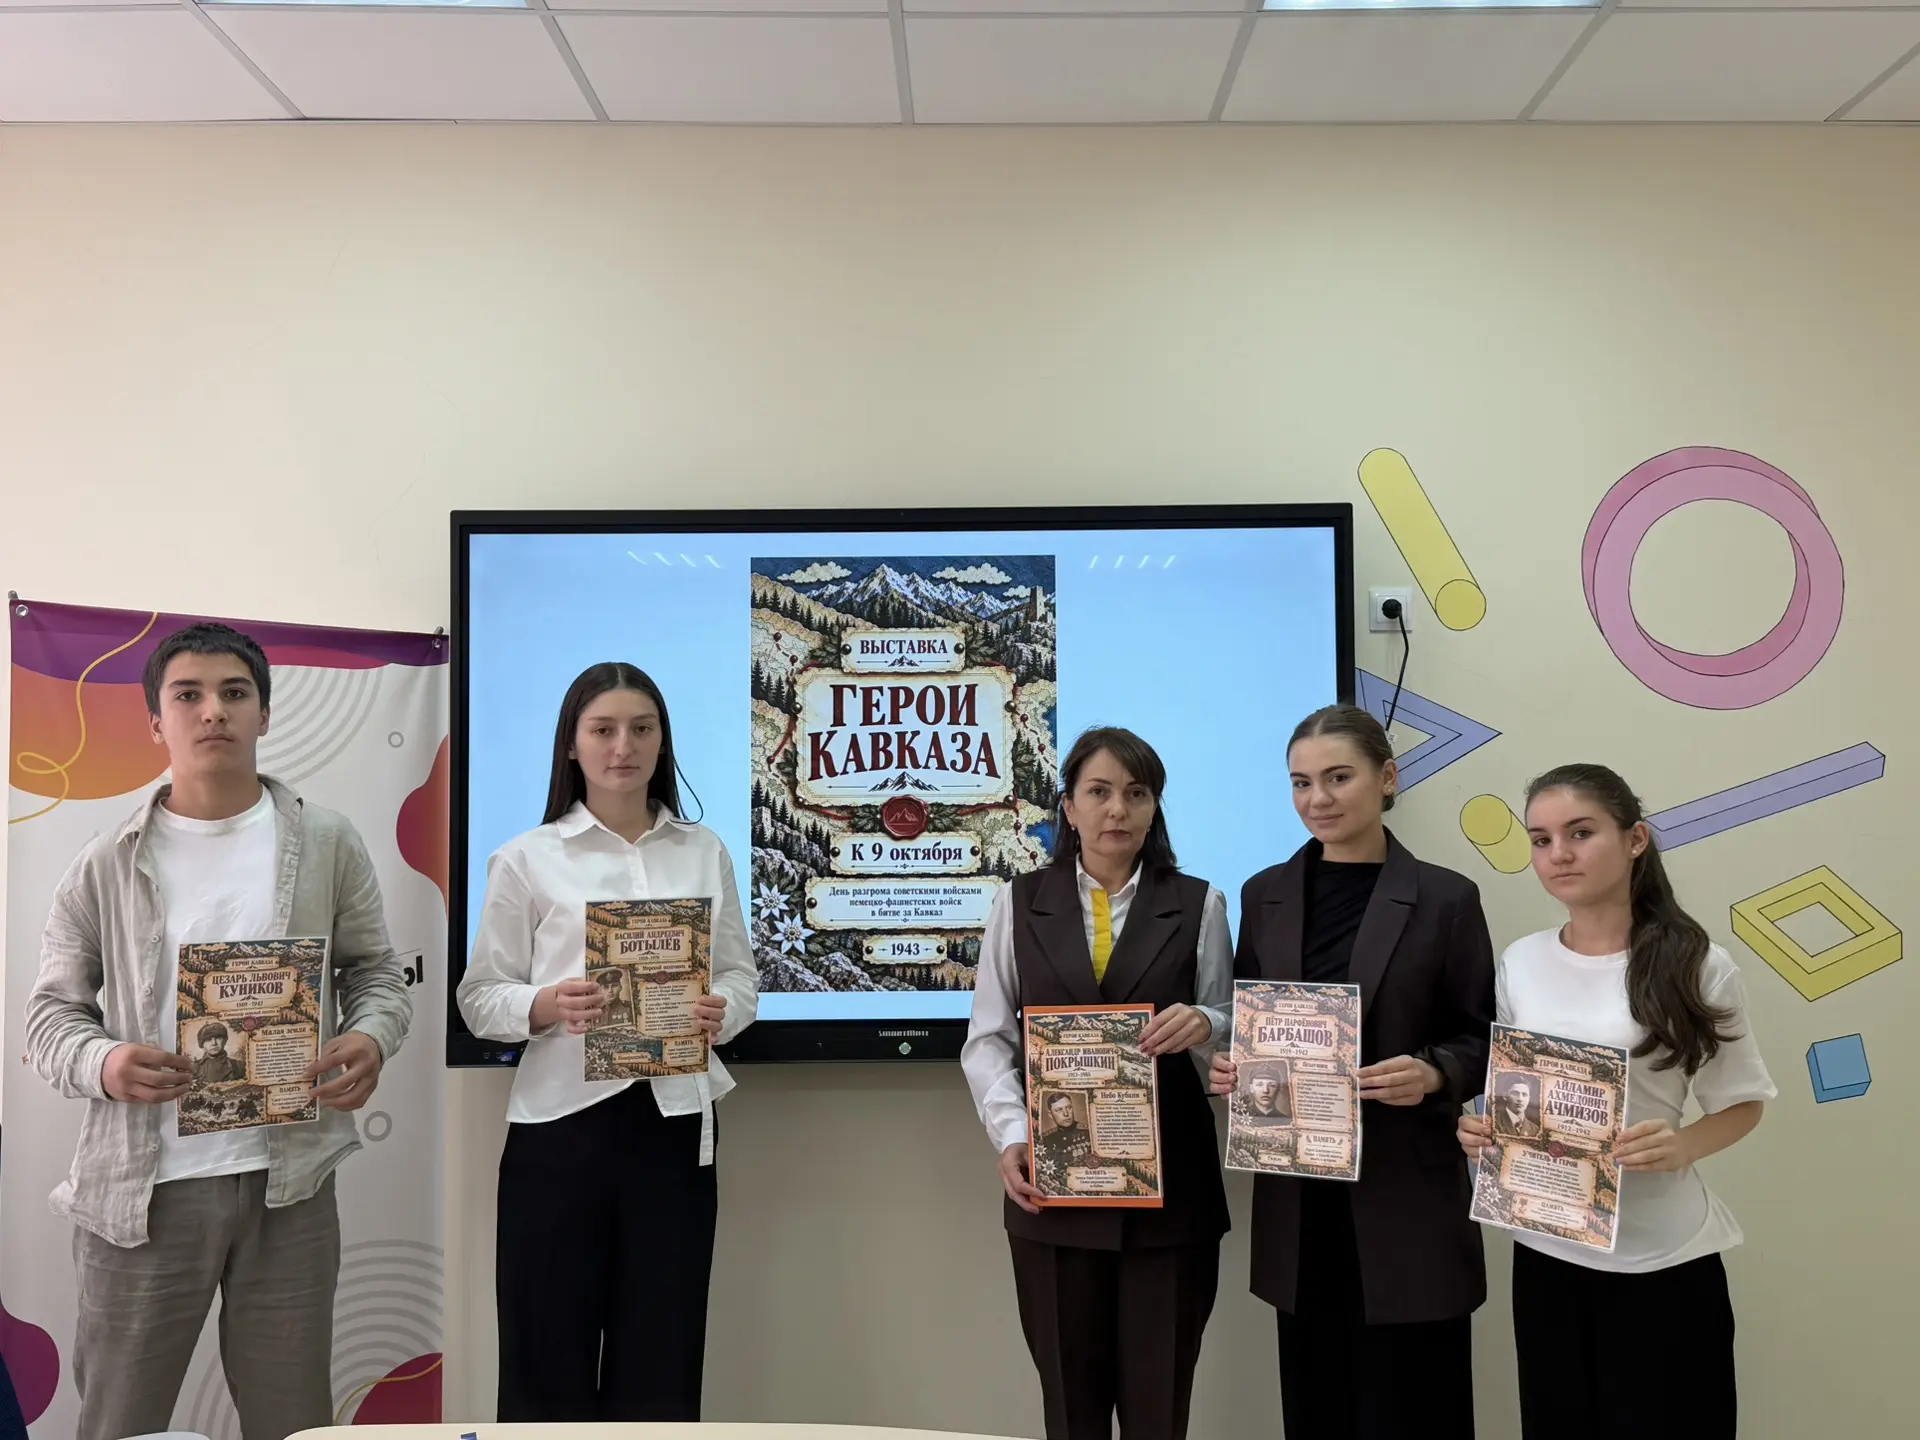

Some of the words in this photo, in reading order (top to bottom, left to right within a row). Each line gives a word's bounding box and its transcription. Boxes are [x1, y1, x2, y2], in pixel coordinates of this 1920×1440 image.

[859, 639, 948, 655] ВЫСТАВКА
[829, 683, 979, 728] ГЕРОИ
[807, 730, 1002, 782] КАВКАЗА
[851, 843, 864, 862] К
[871, 842, 884, 862] 9
[889, 841, 963, 865] октября
[828, 886, 850, 897] День
[852, 887, 891, 898] разгрома
[893, 887, 941, 896] советскими
[943, 886, 982, 896] войсками
[849, 897, 937, 908] немецко-фашистских
[939, 897, 963, 906] войск
[871, 909, 876, 917] в
[878, 907, 900, 917] битве
[903, 909, 912, 917] за
[914, 907, 943, 917] Кавказ
[614, 931, 645, 940] ВАСИЛИЙ
[647, 929, 685, 939] АНДРЕЕВИЧ
[620, 938, 681, 954] БОТЫЛЁВ
[890, 943, 921, 956] 1943
[212, 974, 248, 985] ЦЕЗАРЬ
[249, 971, 291, 982] ЛЬВОВИЧ
[219, 981, 284, 999] КУНИКОВ
[1265, 1016, 1283, 1026] ПЁТР
[1257, 1026, 1333, 1048] БАРБАШОВ
[1045, 1048, 1080, 1056] АЛЕКСАНДР
[1082, 1047, 1115, 1055] ИВАНОВИЧ
[1046, 1056, 1115, 1072] ПОКРЫШКИН
[1539, 1059, 1559, 1068] ГЕРОИ
[1559, 1061, 1588, 1076] КАВКАЗА
[1117, 1092, 1140, 1100] Кубани
[1553, 1079, 1606, 1098] АЙДАМИР
[1547, 1089, 1608, 1109] АХМЕДОВИЧ
[1544, 1100, 1608, 1127] АЧМИЗОВ
[1522, 1150, 1551, 1163] УЧИТЕЛЬ
